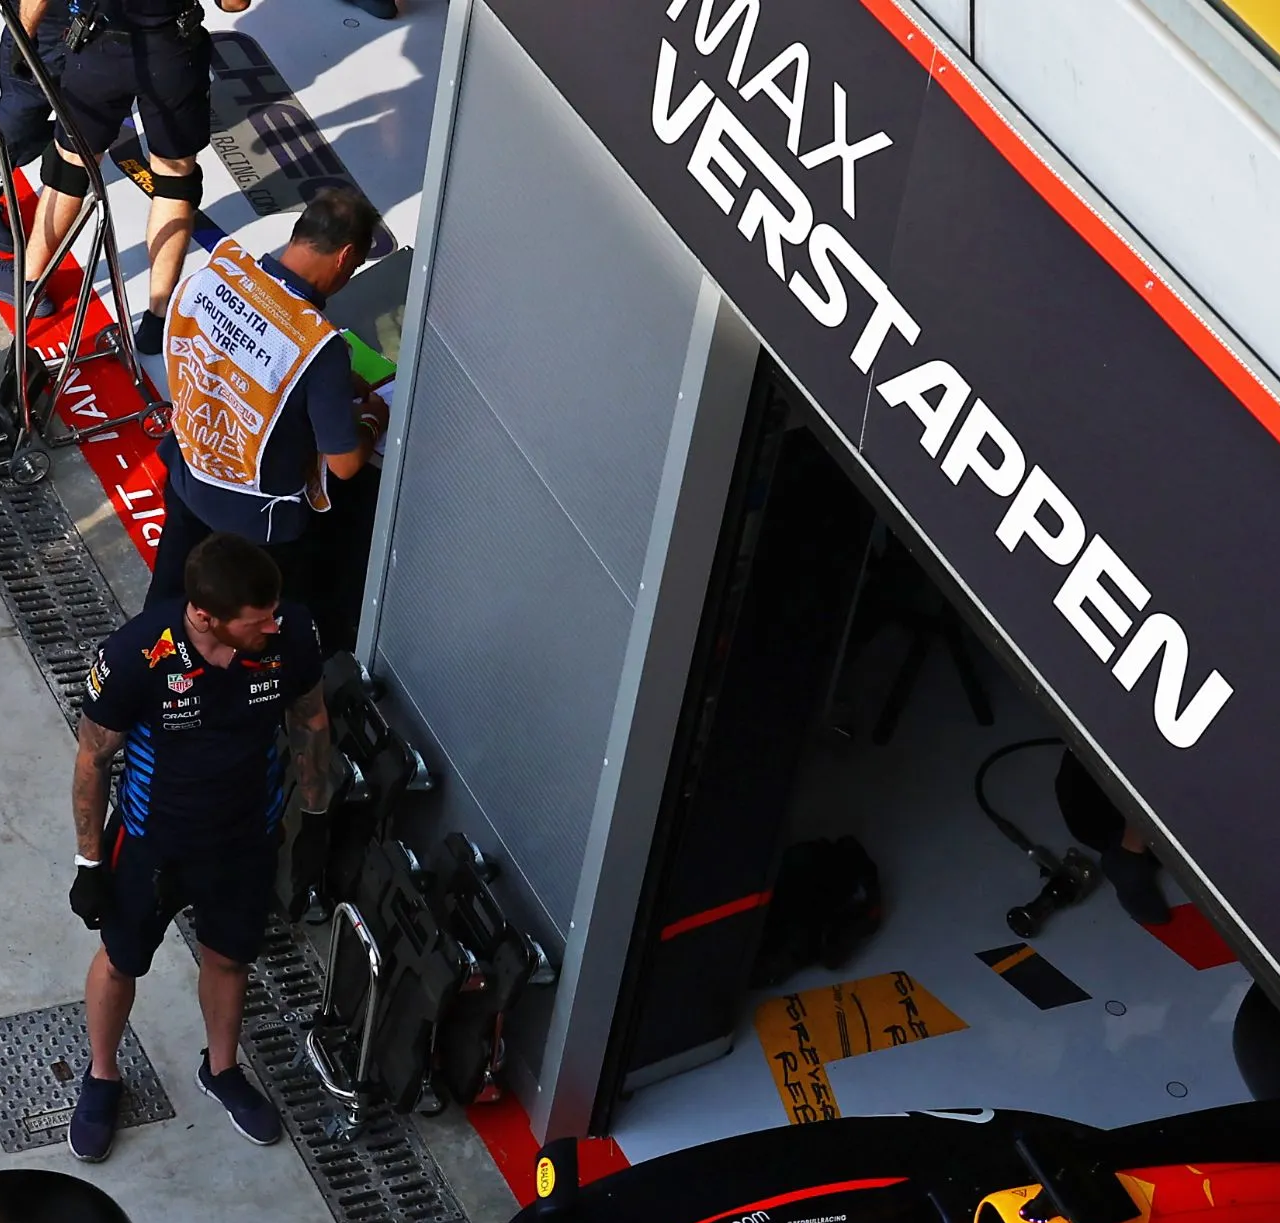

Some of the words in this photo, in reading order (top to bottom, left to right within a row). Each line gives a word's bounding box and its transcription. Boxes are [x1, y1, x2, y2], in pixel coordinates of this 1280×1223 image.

[665, 0, 893, 219] MAX
[194, 292, 257, 356] SCRUTINEER
[255, 347, 272, 368] F1
[215, 283, 269, 337] 0063-ITA
[211, 324, 239, 356] TYRE
[651, 37, 1235, 749] VERSTAPPEN
[176, 641, 193, 669] zoom
[250, 679, 280, 694] BYBIT
